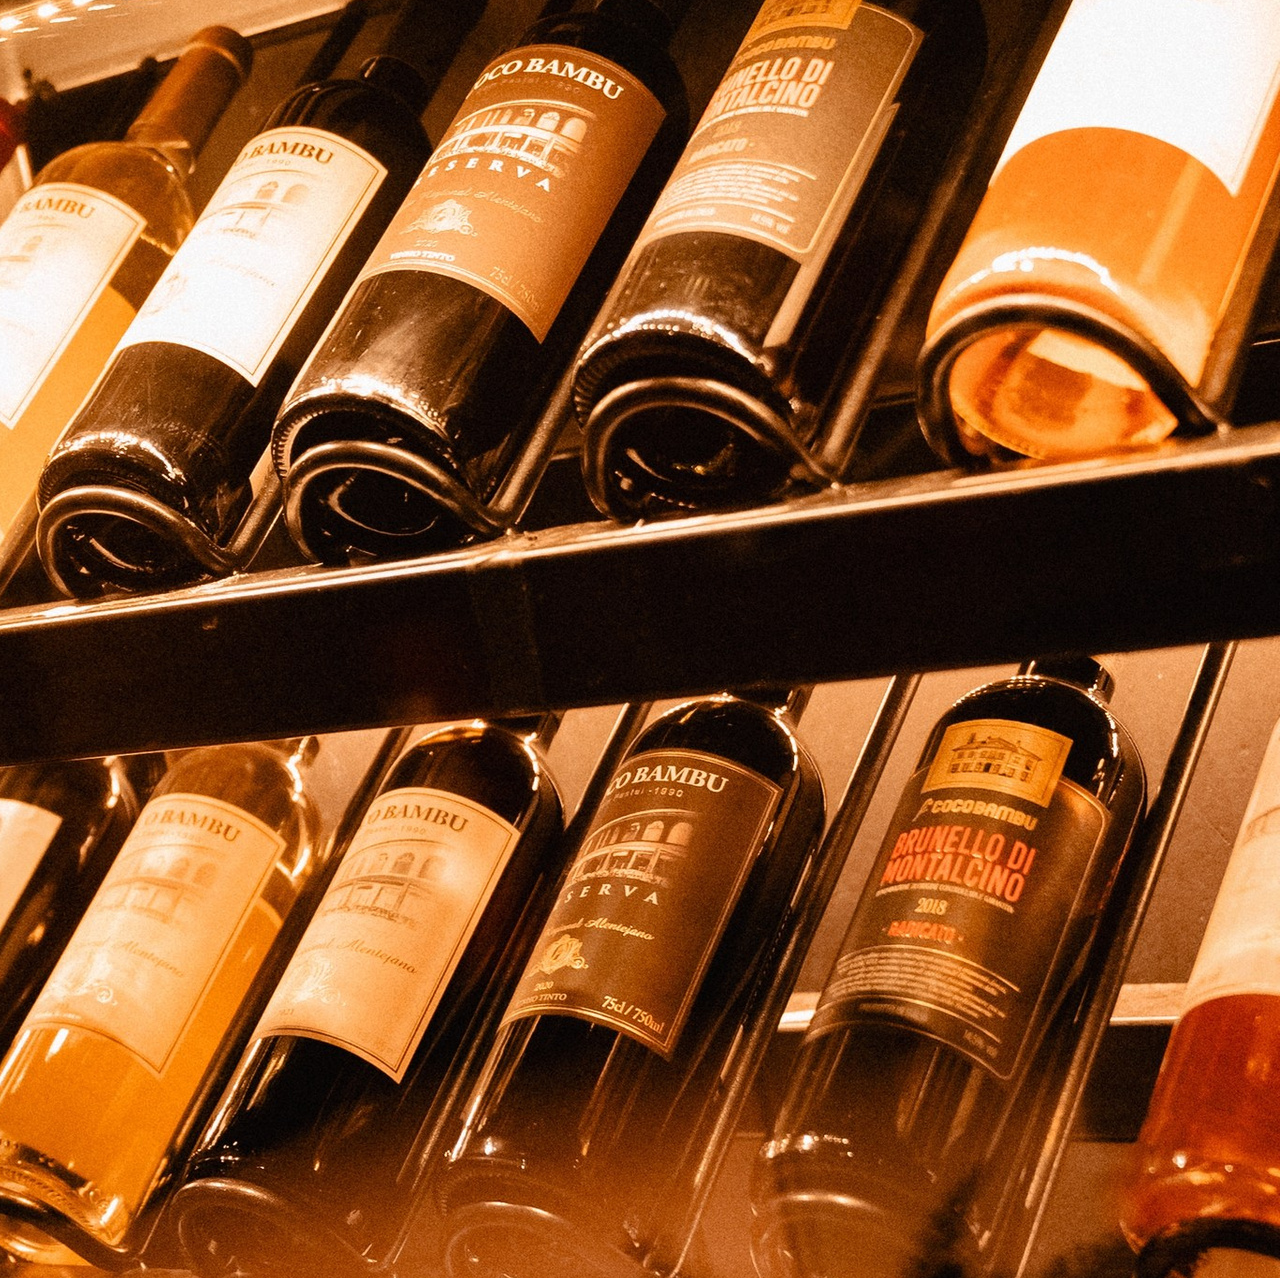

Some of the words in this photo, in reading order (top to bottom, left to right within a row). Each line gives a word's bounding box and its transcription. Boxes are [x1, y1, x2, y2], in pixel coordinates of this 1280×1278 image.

[524, 58, 624, 100] BAMBU
[801, 58, 836, 86] DI
[248, 141, 334, 164] BAMBU
[632, 765, 730, 793] BAMBU
[160, 808, 241, 842] BAMBU
[382, 803, 469, 832] BAMBU
[930, 798, 1039, 831] COCOBAMBU
[891, 825, 1006, 863] BRUNELLO
[1007, 839, 1038, 876] DI
[880, 852, 1026, 903] MONTALCINO
[564, 882, 660, 906] SERVA
[914, 896, 949, 915] 2018
[584, 917, 656, 941] Alentejano
[538, 993, 568, 1003] TINTO
[601, 995, 626, 1015] 75cl
[632, 1007, 666, 1034] 750ml
